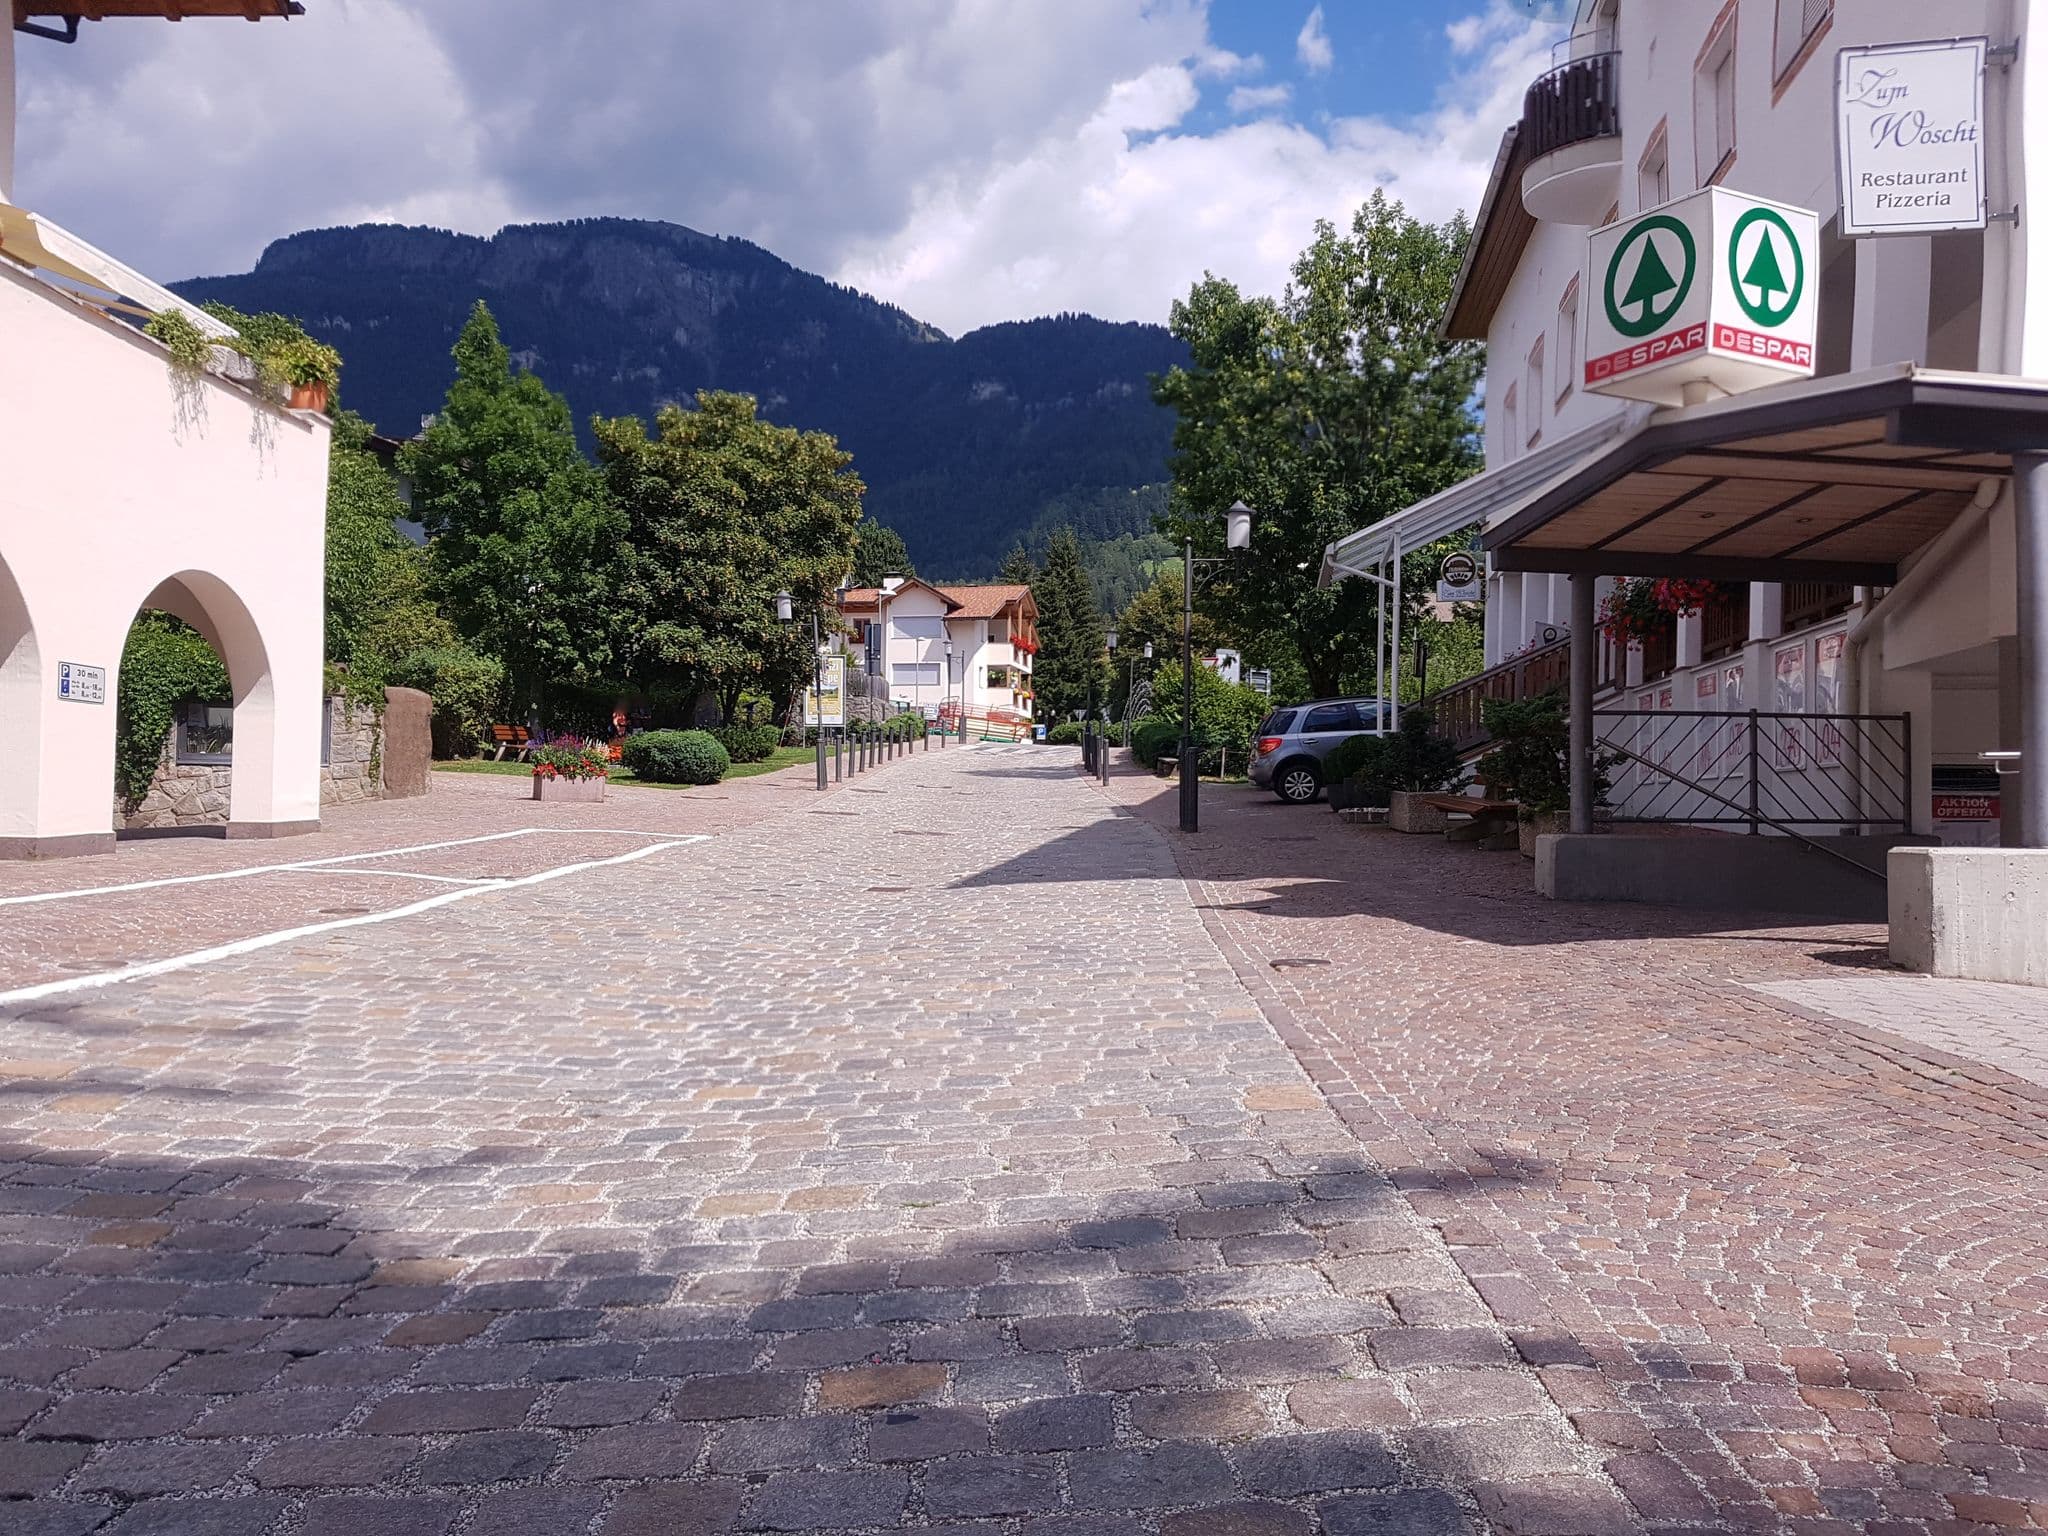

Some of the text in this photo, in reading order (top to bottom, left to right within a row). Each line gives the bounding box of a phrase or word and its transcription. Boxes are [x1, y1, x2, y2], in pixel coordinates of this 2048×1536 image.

[1846, 68, 1909, 108] Zum
[1870, 110, 1978, 149] Woscht
[1861, 168, 1968, 187] Restaurant
[1876, 191, 1951, 208] Pizzeria
[1593, 329, 1705, 377] DESPAR
[1719, 328, 1810, 364] DESPAR
[77, 669, 98, 679] 30 min
[1937, 807, 1993, 817] OFFERTA
[1941, 799, 1988, 807] AKTION
